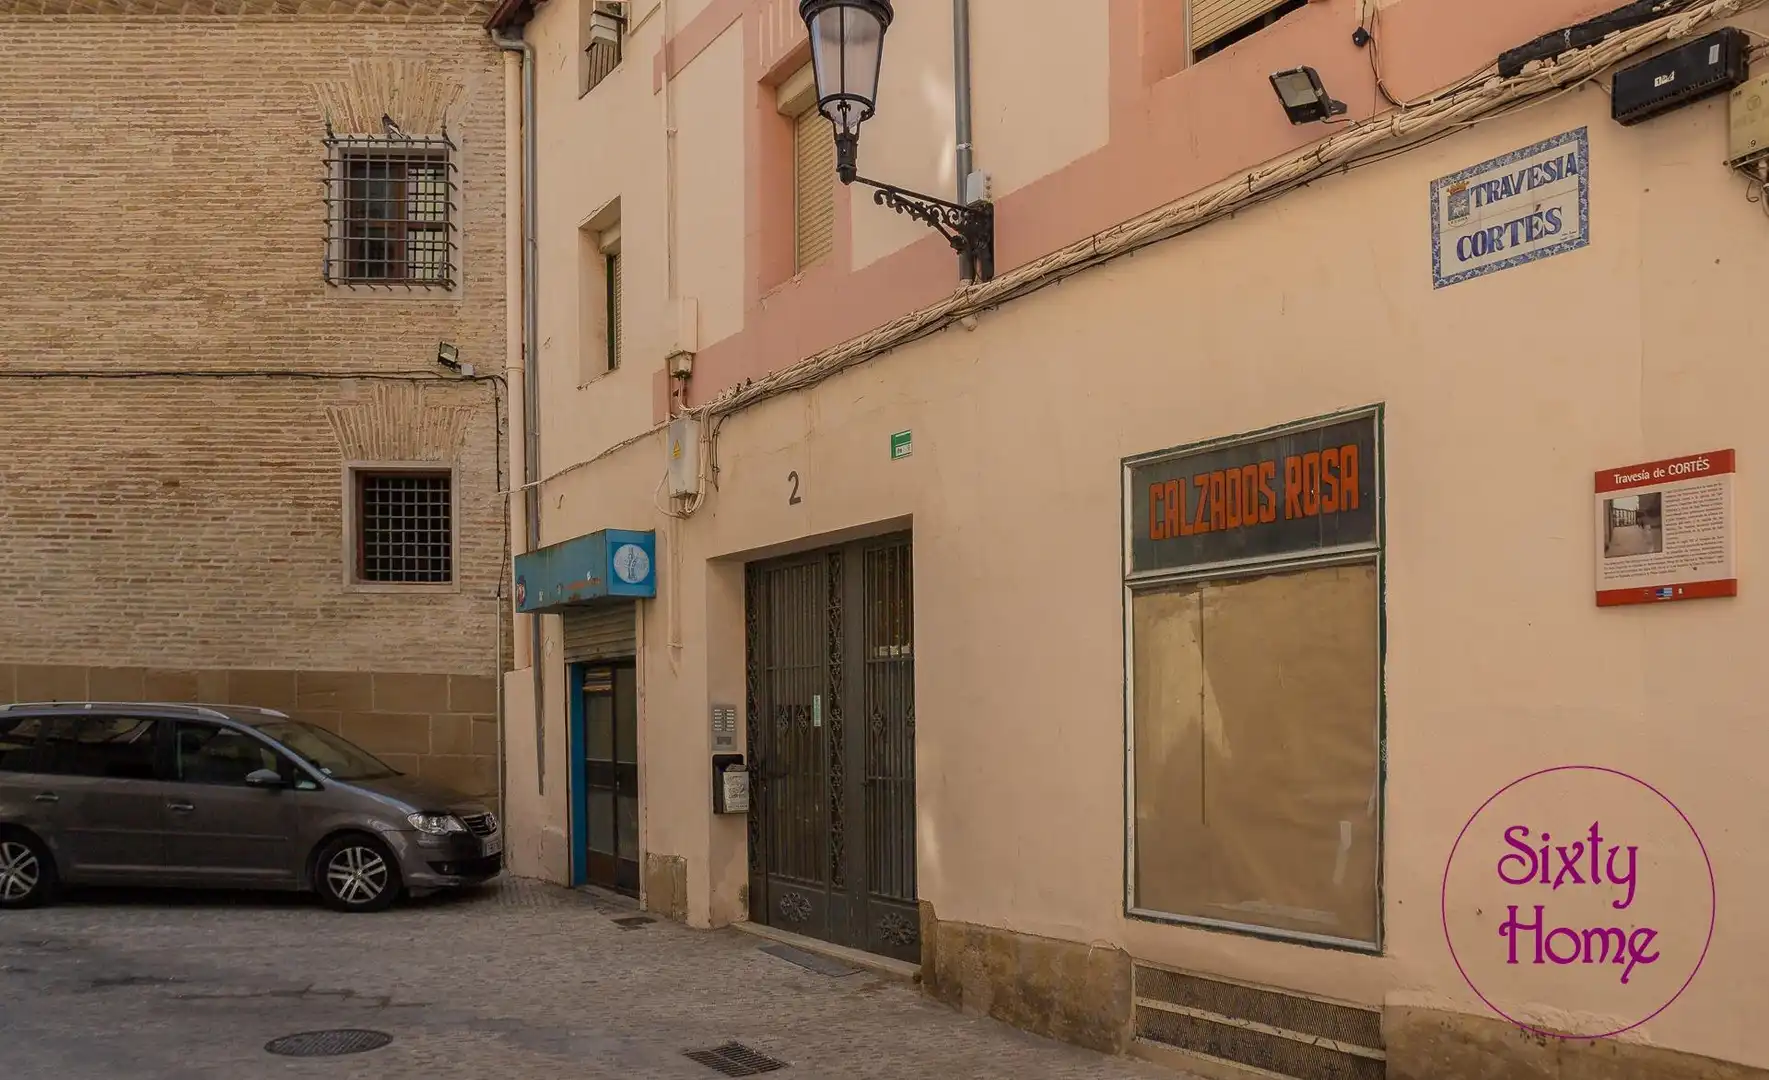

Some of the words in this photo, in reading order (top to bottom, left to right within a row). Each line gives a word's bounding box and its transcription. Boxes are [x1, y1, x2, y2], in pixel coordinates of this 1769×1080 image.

[1456, 204, 1562, 262] CORTÉS
[788, 470, 801, 505] 2
[1653, 468, 1665, 478] de
[1668, 456, 1710, 475] CORTÉS
[1149, 460, 1277, 540] CALZADOS
[1284, 444, 1359, 520] ROSA
